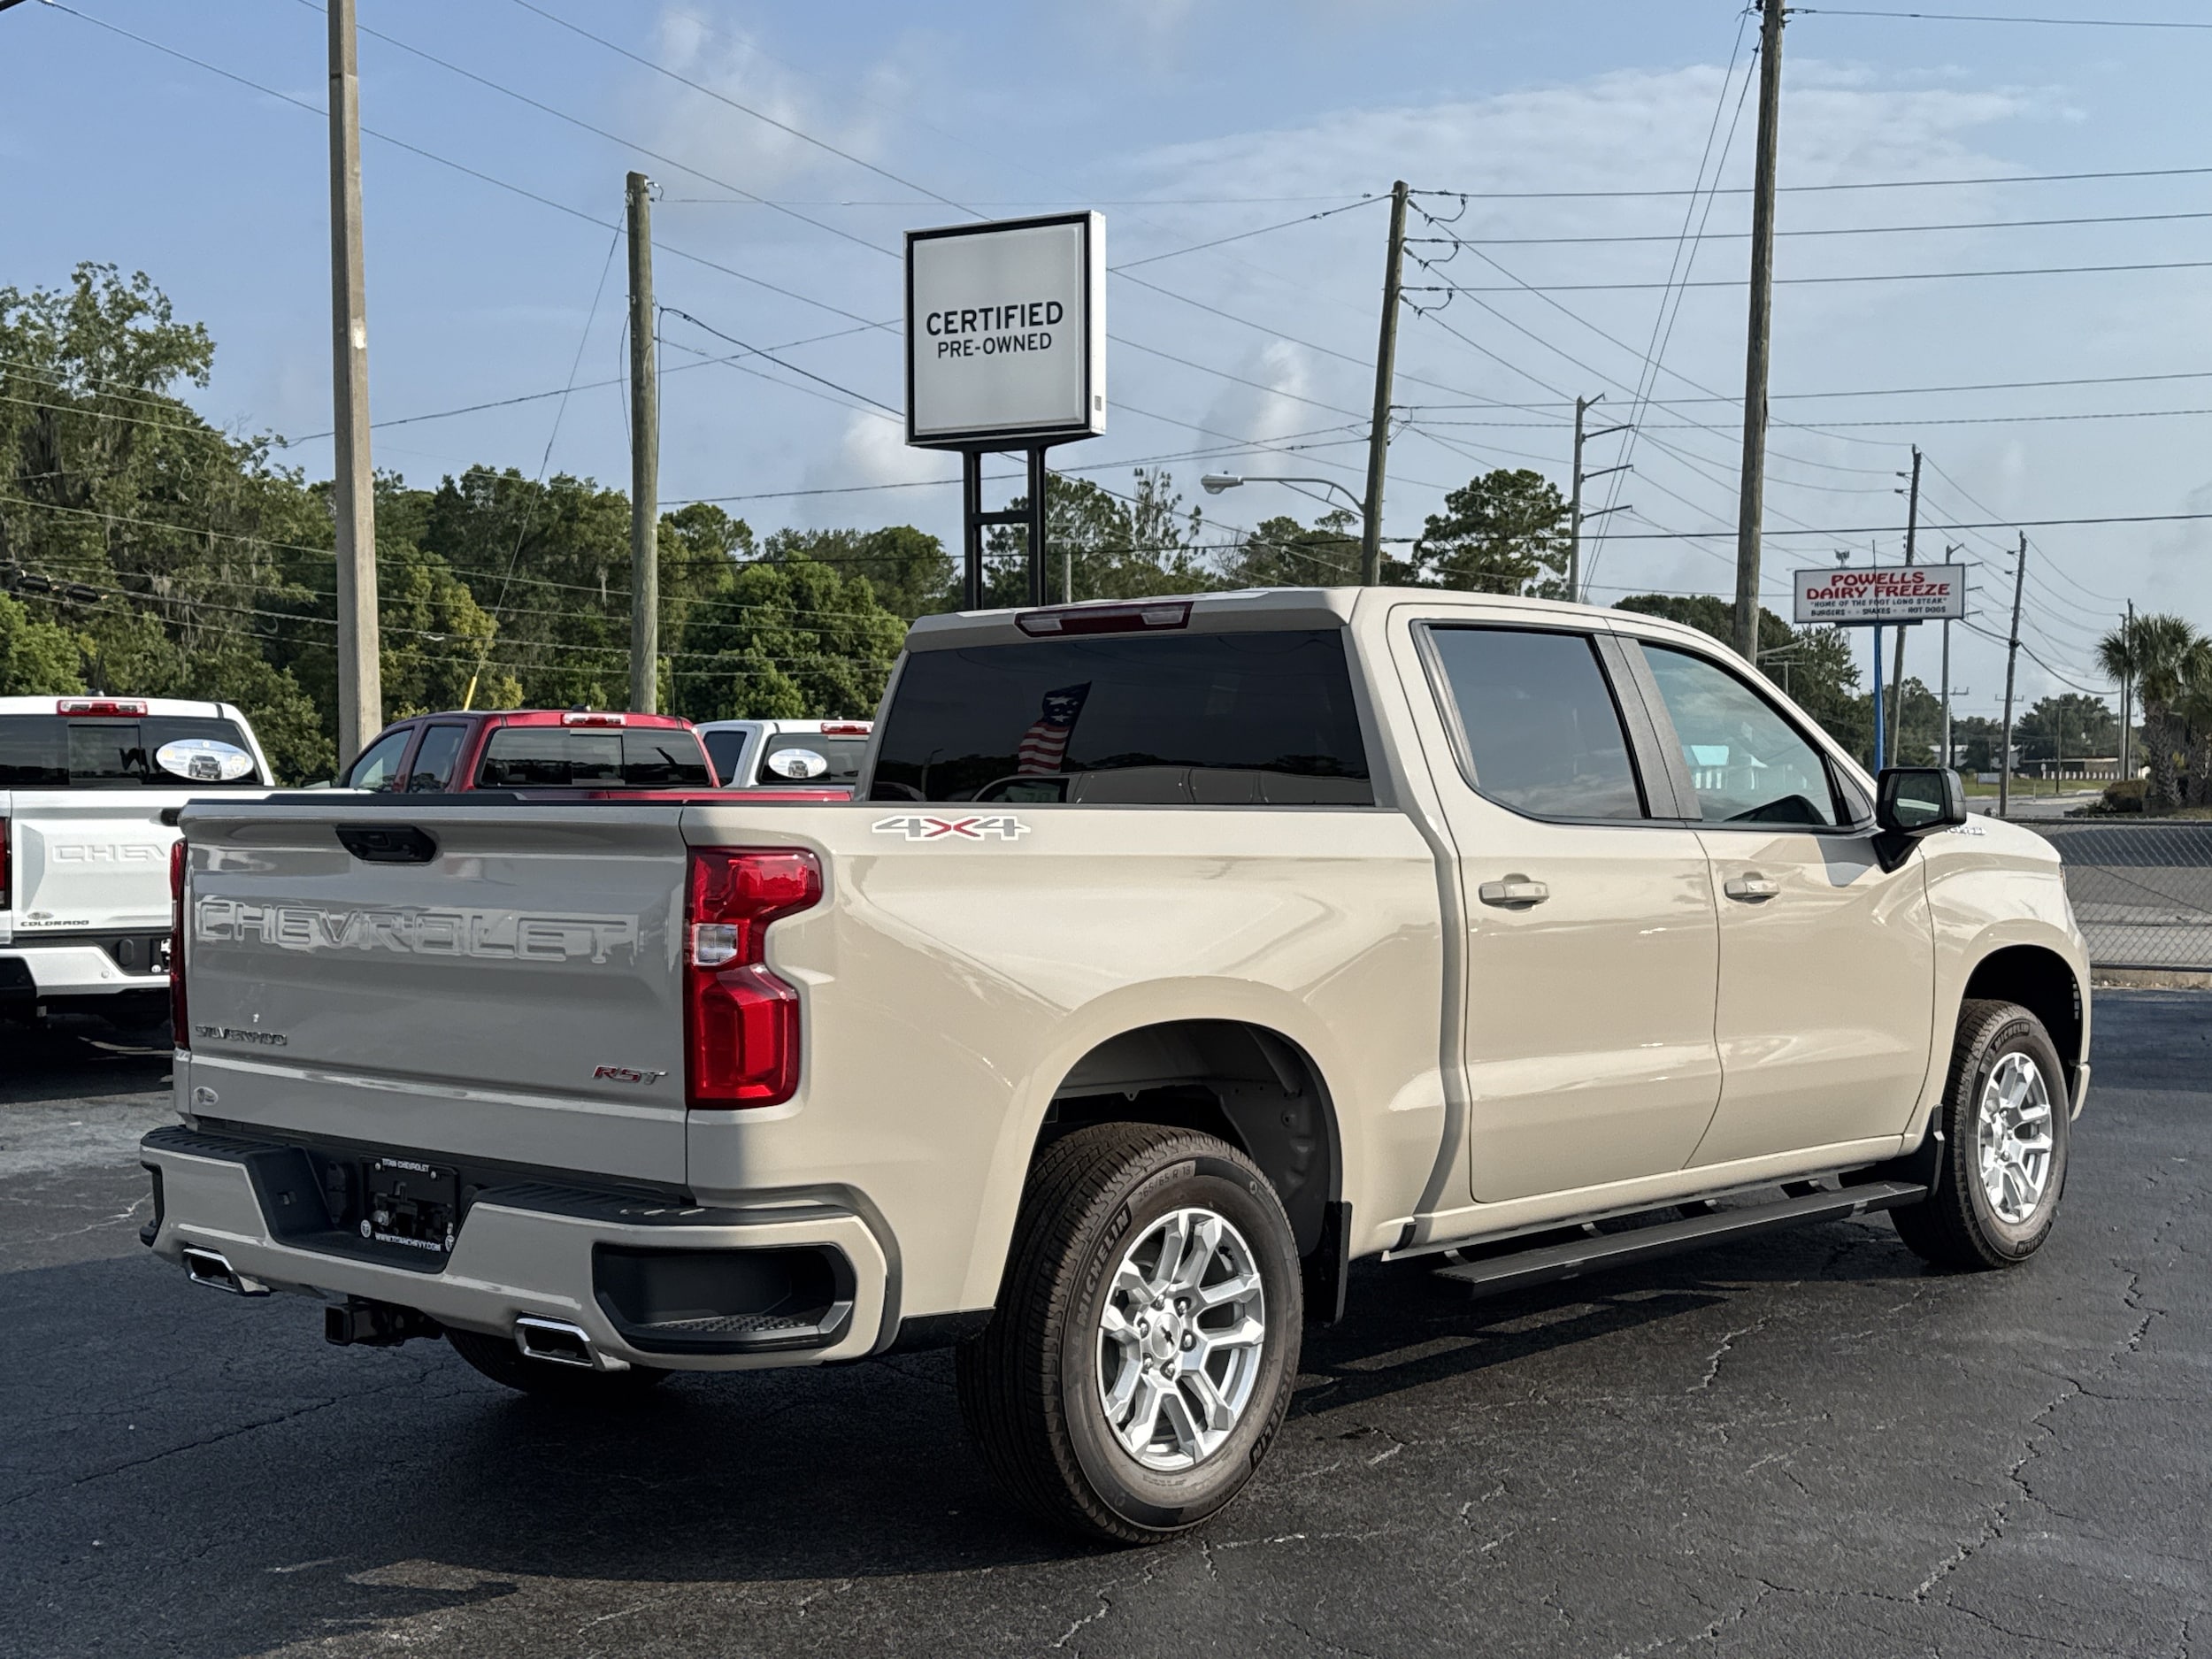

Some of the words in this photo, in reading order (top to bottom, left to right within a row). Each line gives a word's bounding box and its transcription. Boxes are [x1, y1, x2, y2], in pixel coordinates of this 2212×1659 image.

[926, 300, 1064, 336] CERTIFIED
[938, 332, 1052, 358] PRE-OWNED
[1807, 586, 1868, 600] DAIRY
[1874, 583, 1951, 598] FREEZE
[1831, 571, 1925, 587] POWELLS
[197, 900, 630, 964] CHEVROLET
[591, 1065, 668, 1085] RST
[1077, 1209, 1129, 1326] MICHELIN
